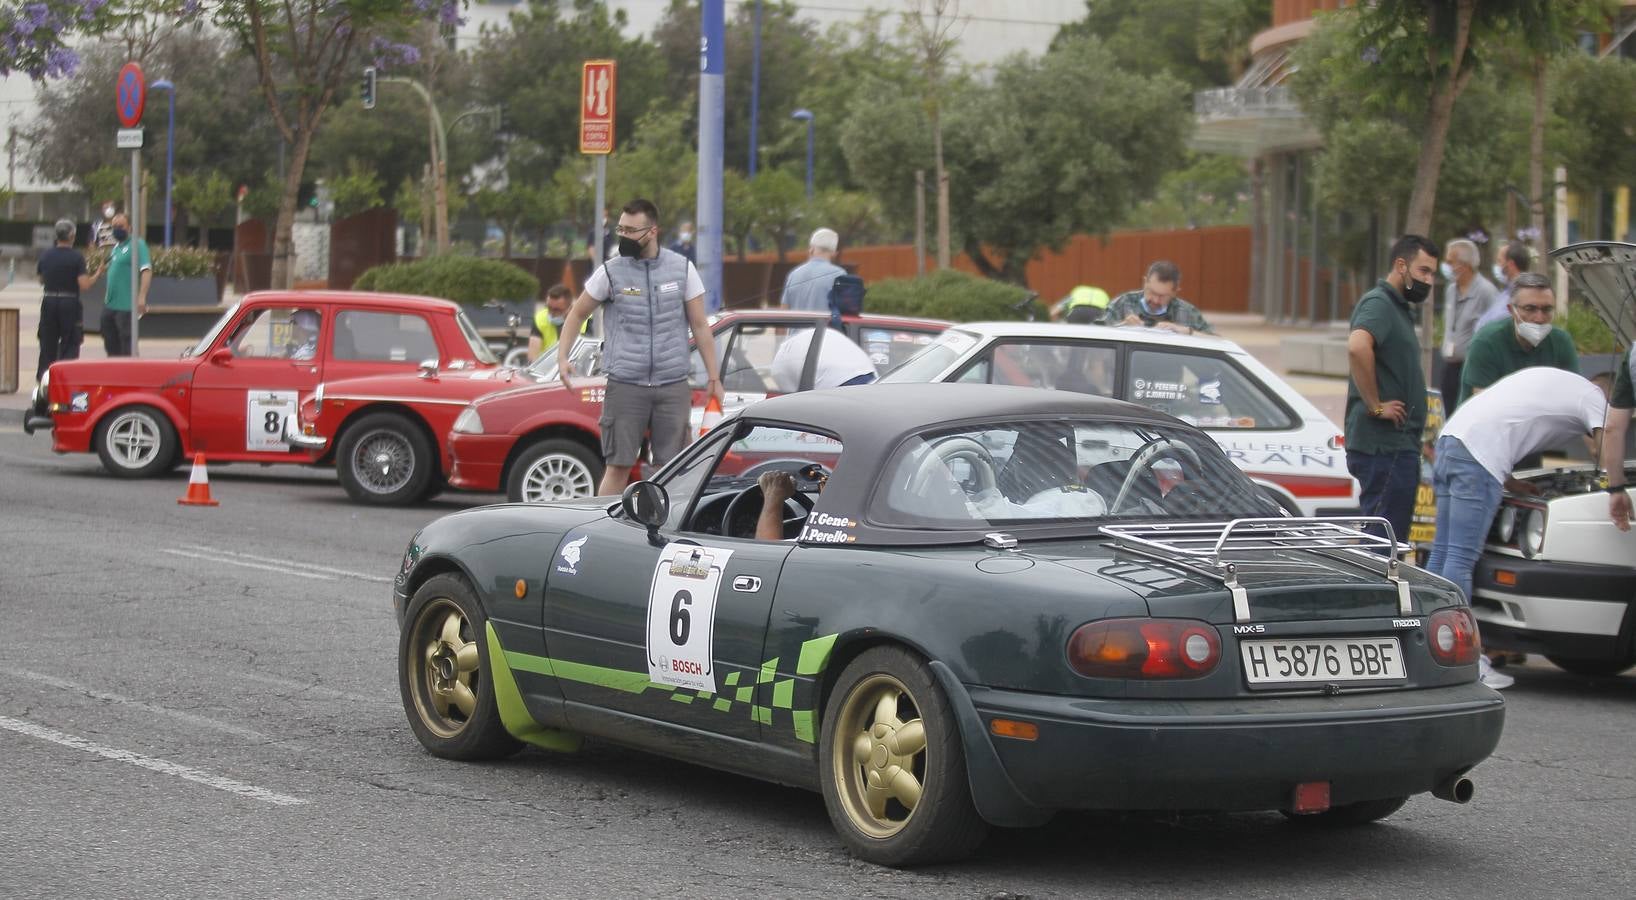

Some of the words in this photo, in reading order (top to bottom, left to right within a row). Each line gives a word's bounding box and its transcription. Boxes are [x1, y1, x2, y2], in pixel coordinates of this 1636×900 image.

[264, 411, 280, 434] 8
[1217, 440, 1326, 455] ALLERES
[1226, 450, 1334, 468] RAN
[809, 511, 849, 527] T.Gene
[669, 589, 693, 647] 6
[1392, 619, 1421, 628] mazda
[672, 659, 703, 676] BOSCH
[1249, 646, 1270, 678] H
[1273, 644, 1341, 677] 5876
[1347, 643, 1394, 676] BBF
